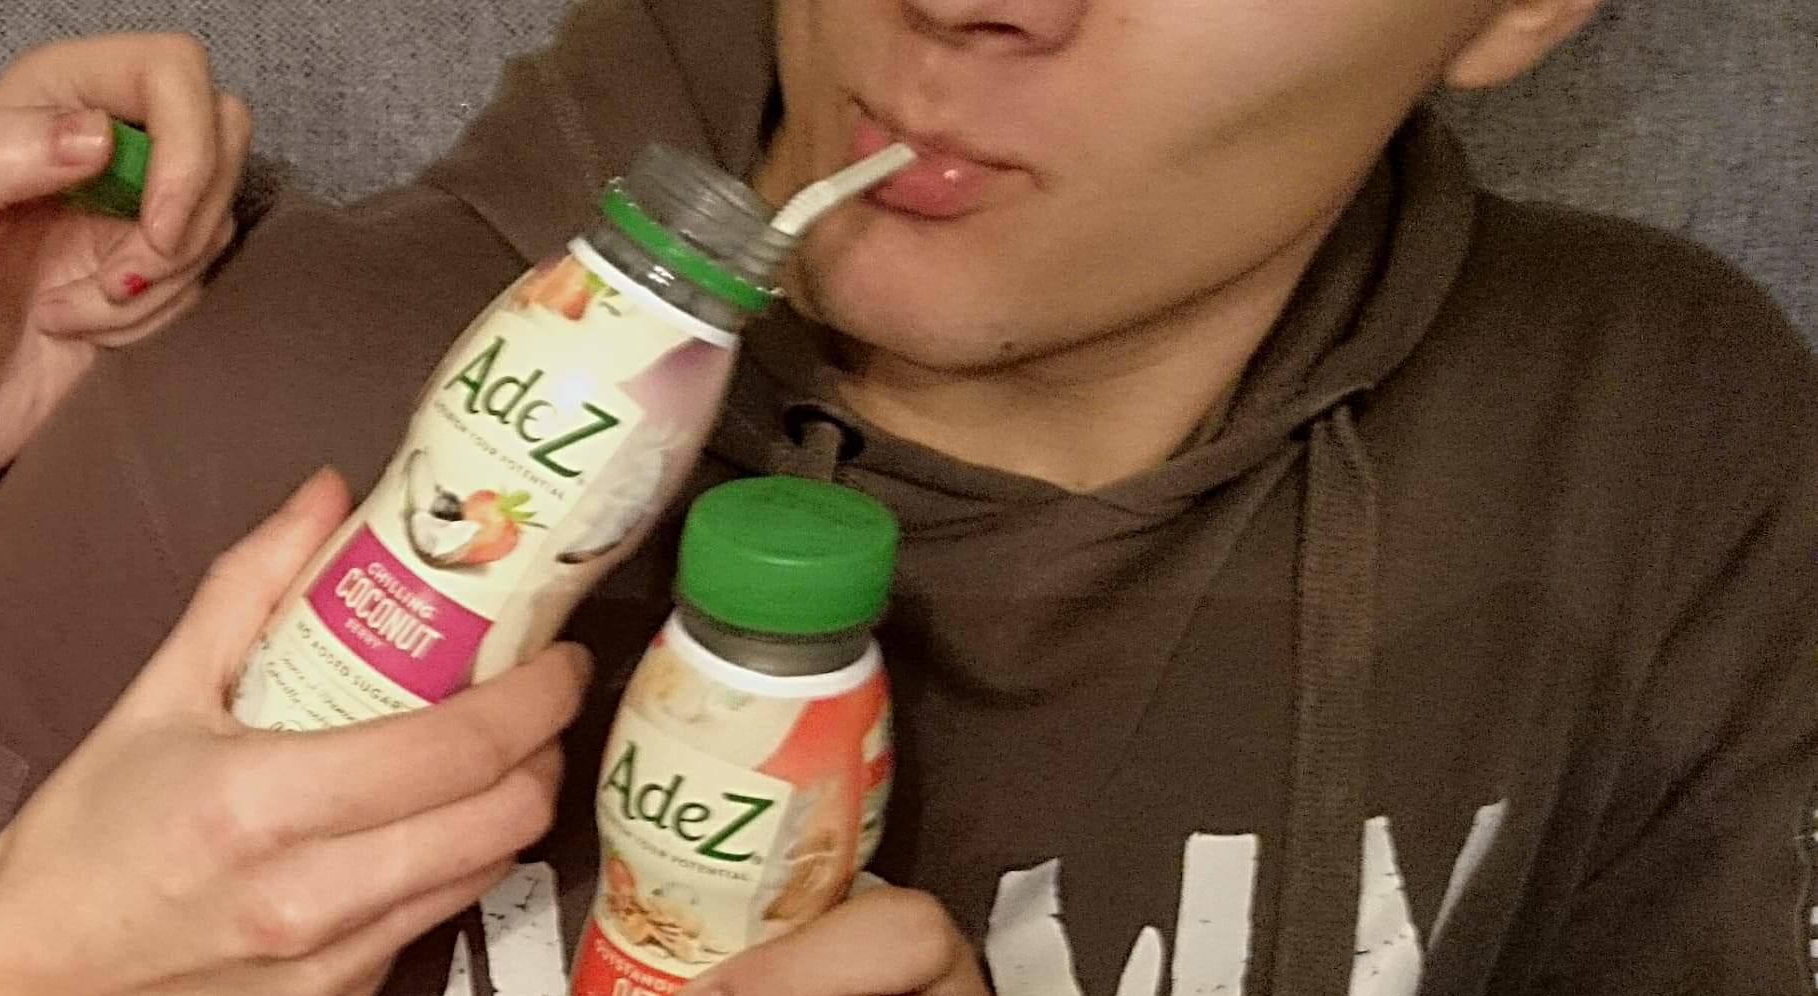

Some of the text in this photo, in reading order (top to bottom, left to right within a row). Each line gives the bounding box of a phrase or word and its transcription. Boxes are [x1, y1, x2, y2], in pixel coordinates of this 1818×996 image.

[443, 334, 619, 478] AdeZ
[334, 567, 447, 659] COCONUT
[367, 561, 437, 620] CHILLING
[311, 641, 350, 677] ADDED
[353, 674, 406, 709] SUGAR
[602, 740, 775, 862] AdeZ
